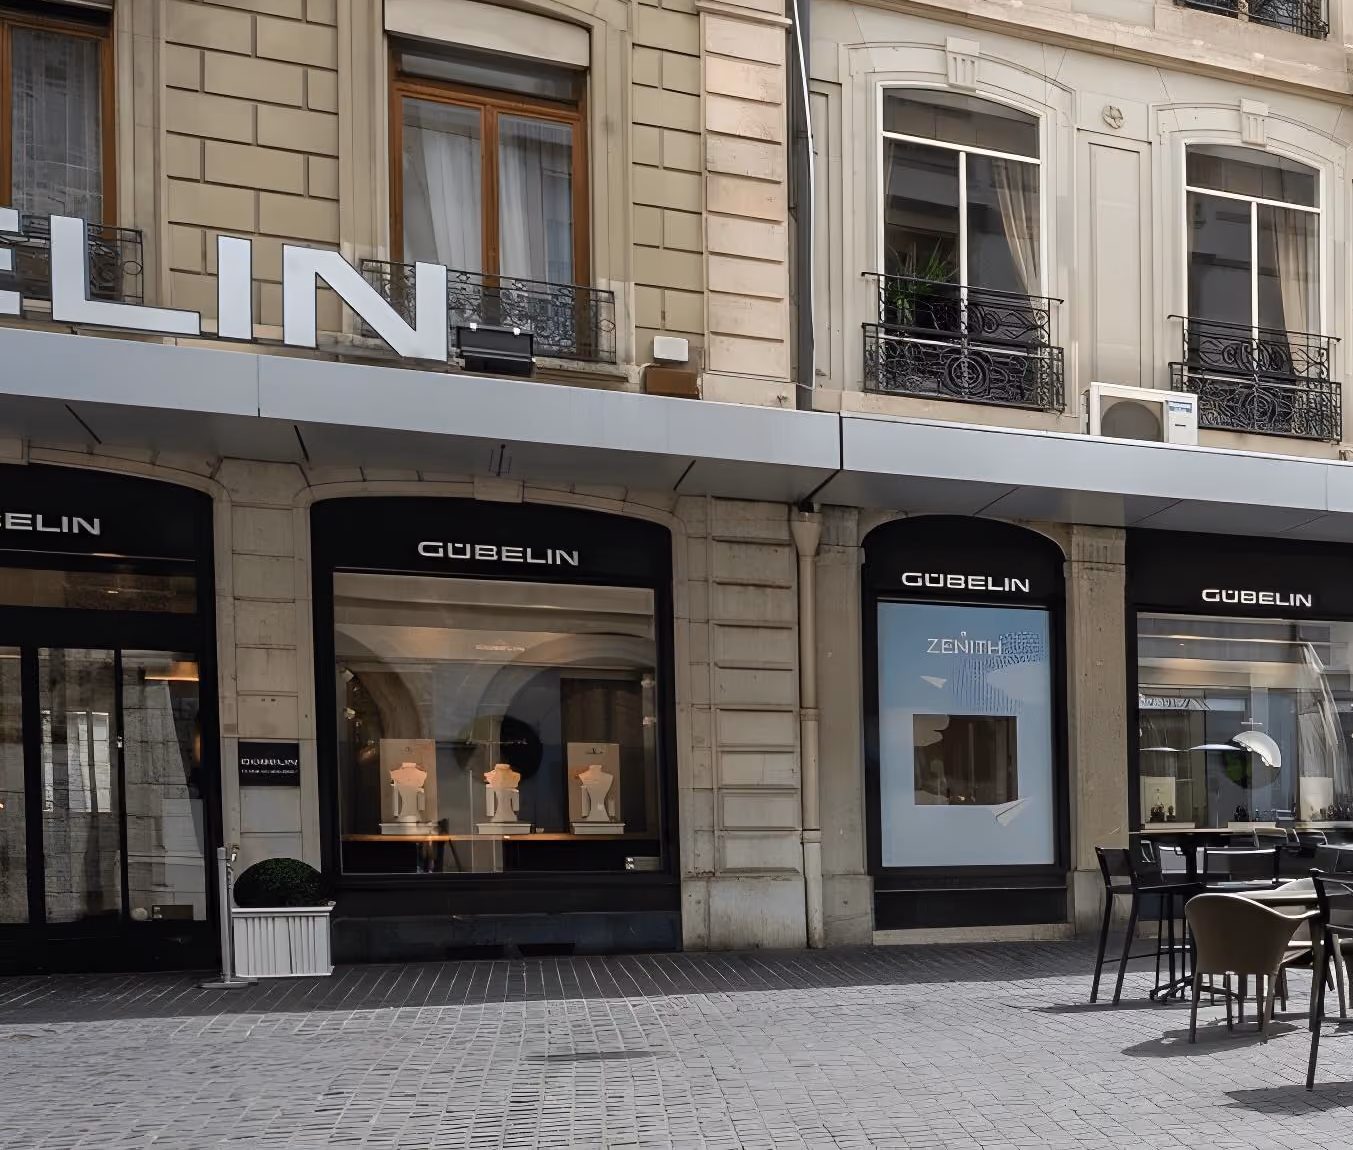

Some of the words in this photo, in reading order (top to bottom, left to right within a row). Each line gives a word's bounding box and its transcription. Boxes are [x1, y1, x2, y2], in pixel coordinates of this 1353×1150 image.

[0, 207, 448, 362] LIN
[0, 512, 100, 536] ELIN
[417, 541, 579, 566] GÜBELIN
[901, 572, 1030, 593] GÜBELIN
[1201, 589, 1312, 607] GÜBELIN
[926, 637, 1002, 654] ZENITH
